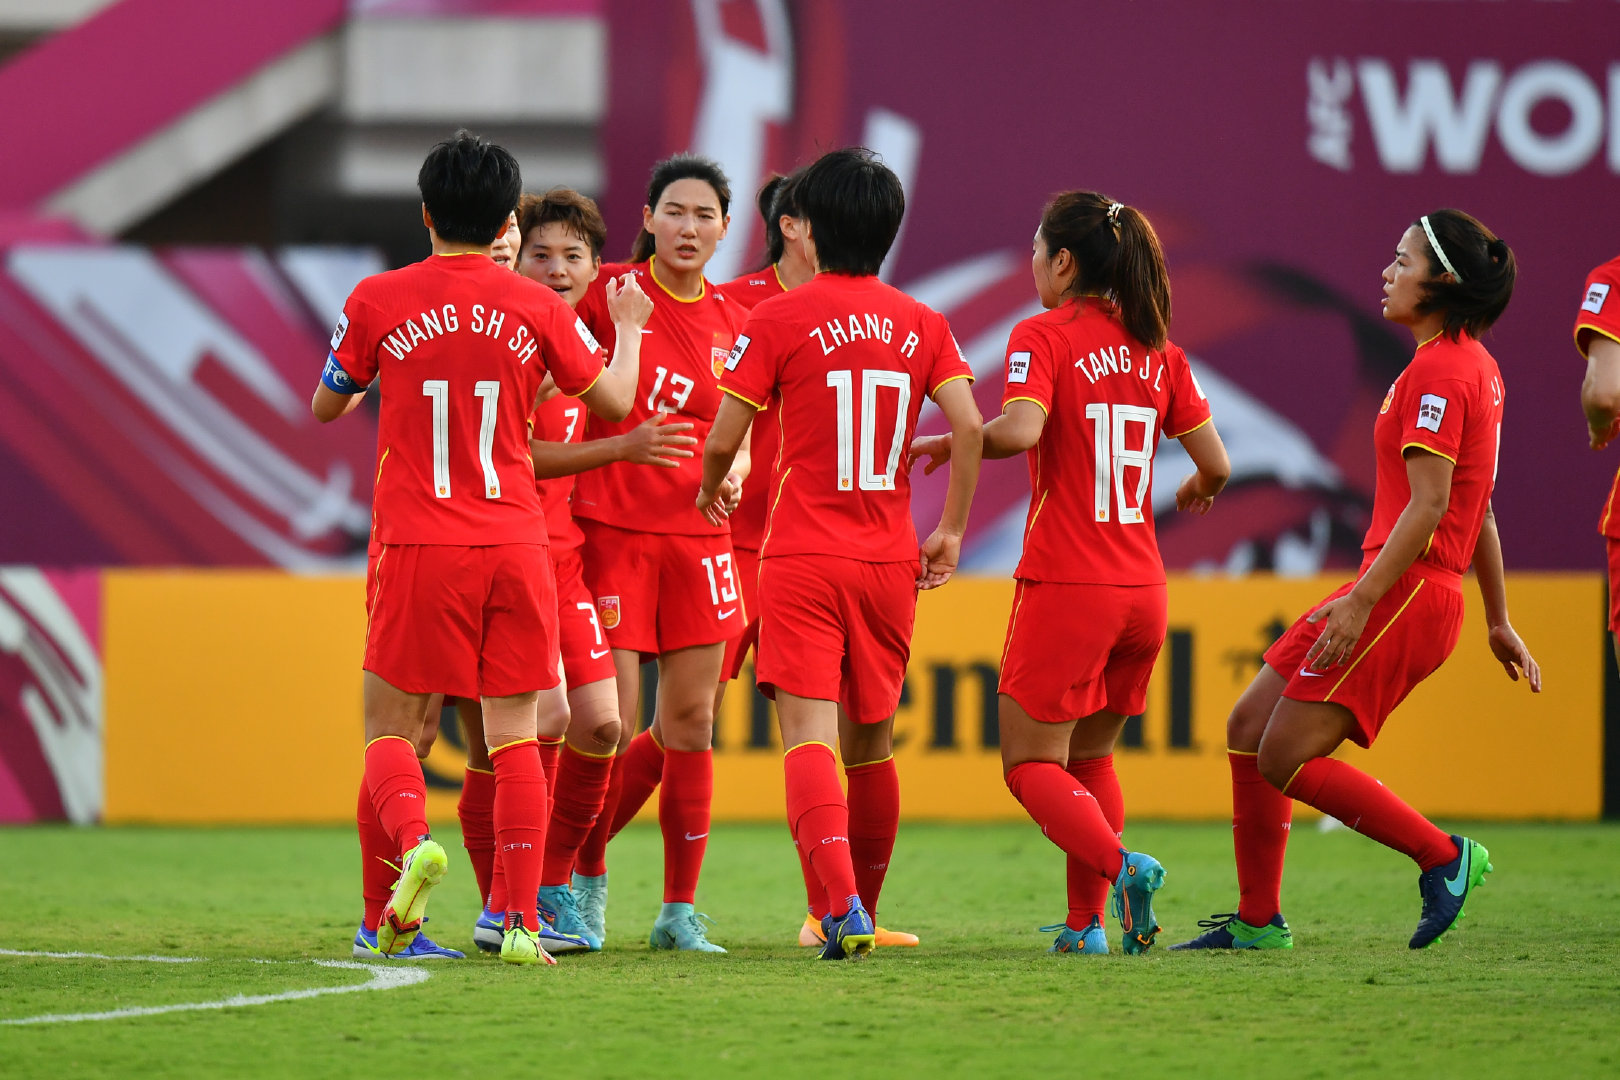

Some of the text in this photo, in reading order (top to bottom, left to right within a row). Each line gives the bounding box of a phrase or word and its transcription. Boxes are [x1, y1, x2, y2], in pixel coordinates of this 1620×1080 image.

[1356, 57, 1620, 177] WO
[382, 304, 459, 361] WANG
[471, 304, 505, 340] SH
[508, 325, 538, 365] SH
[808, 313, 919, 359] ZHANG R
[648, 366, 695, 414] 13
[1074, 345, 1163, 393] TANG J L
[422, 379, 501, 499] 11
[564, 407, 579, 444] 7
[826, 369, 911, 491] 10
[1086, 403, 1158, 525] 18
[701, 552, 738, 606] 13
[576, 601, 602, 645] 7
[503, 842, 532, 852] CFA
